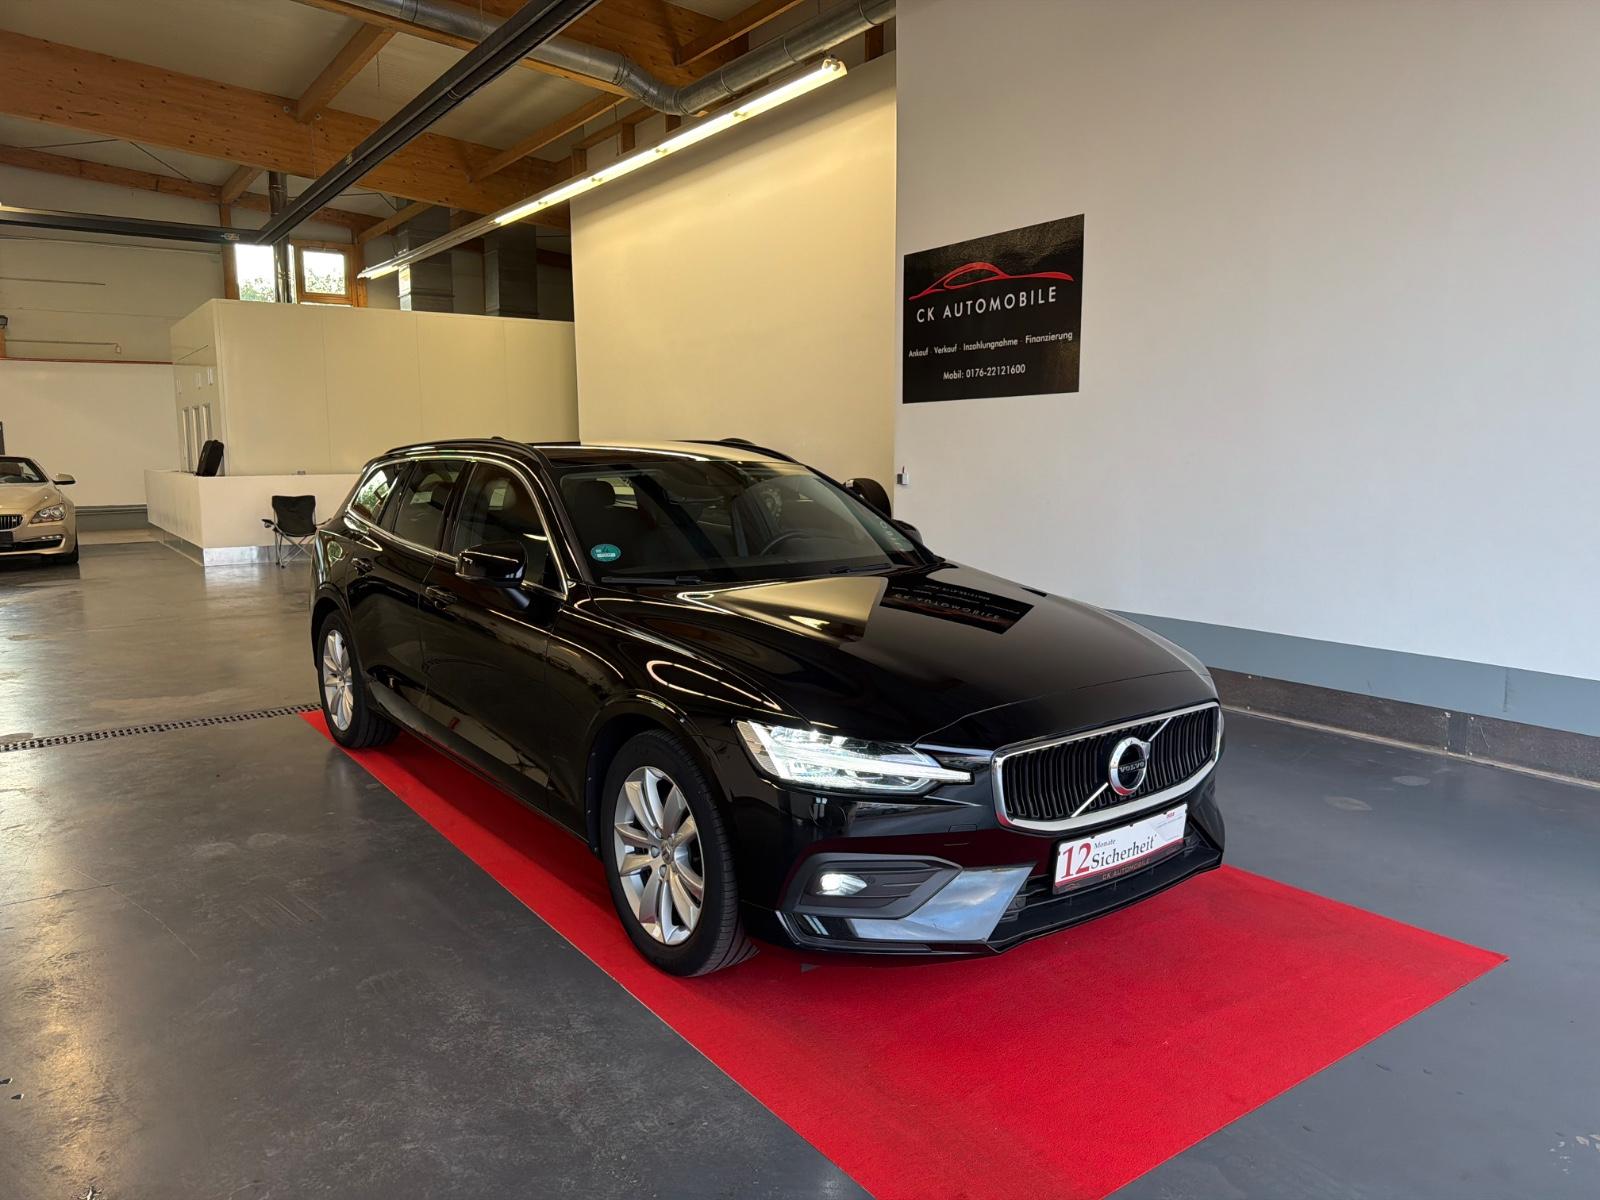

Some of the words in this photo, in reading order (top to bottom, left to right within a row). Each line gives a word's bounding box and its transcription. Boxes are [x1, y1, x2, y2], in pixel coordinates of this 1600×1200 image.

[916, 307, 935, 323] CK
[943, 286, 1056, 319] AUTOMOBILE
[908, 349, 929, 358] Ankauf
[934, 344, 958, 354] Verkauf
[963, 337, 1019, 351] Inzahlungnahme
[1025, 332, 1073, 344] Finanzierung
[943, 369, 964, 380] Mobil:
[965, 364, 1026, 378] 0176-22121600
[1119, 761, 1144, 772] VOLVO
[1094, 839, 1117, 849] Monate
[1061, 842, 1091, 879] 12
